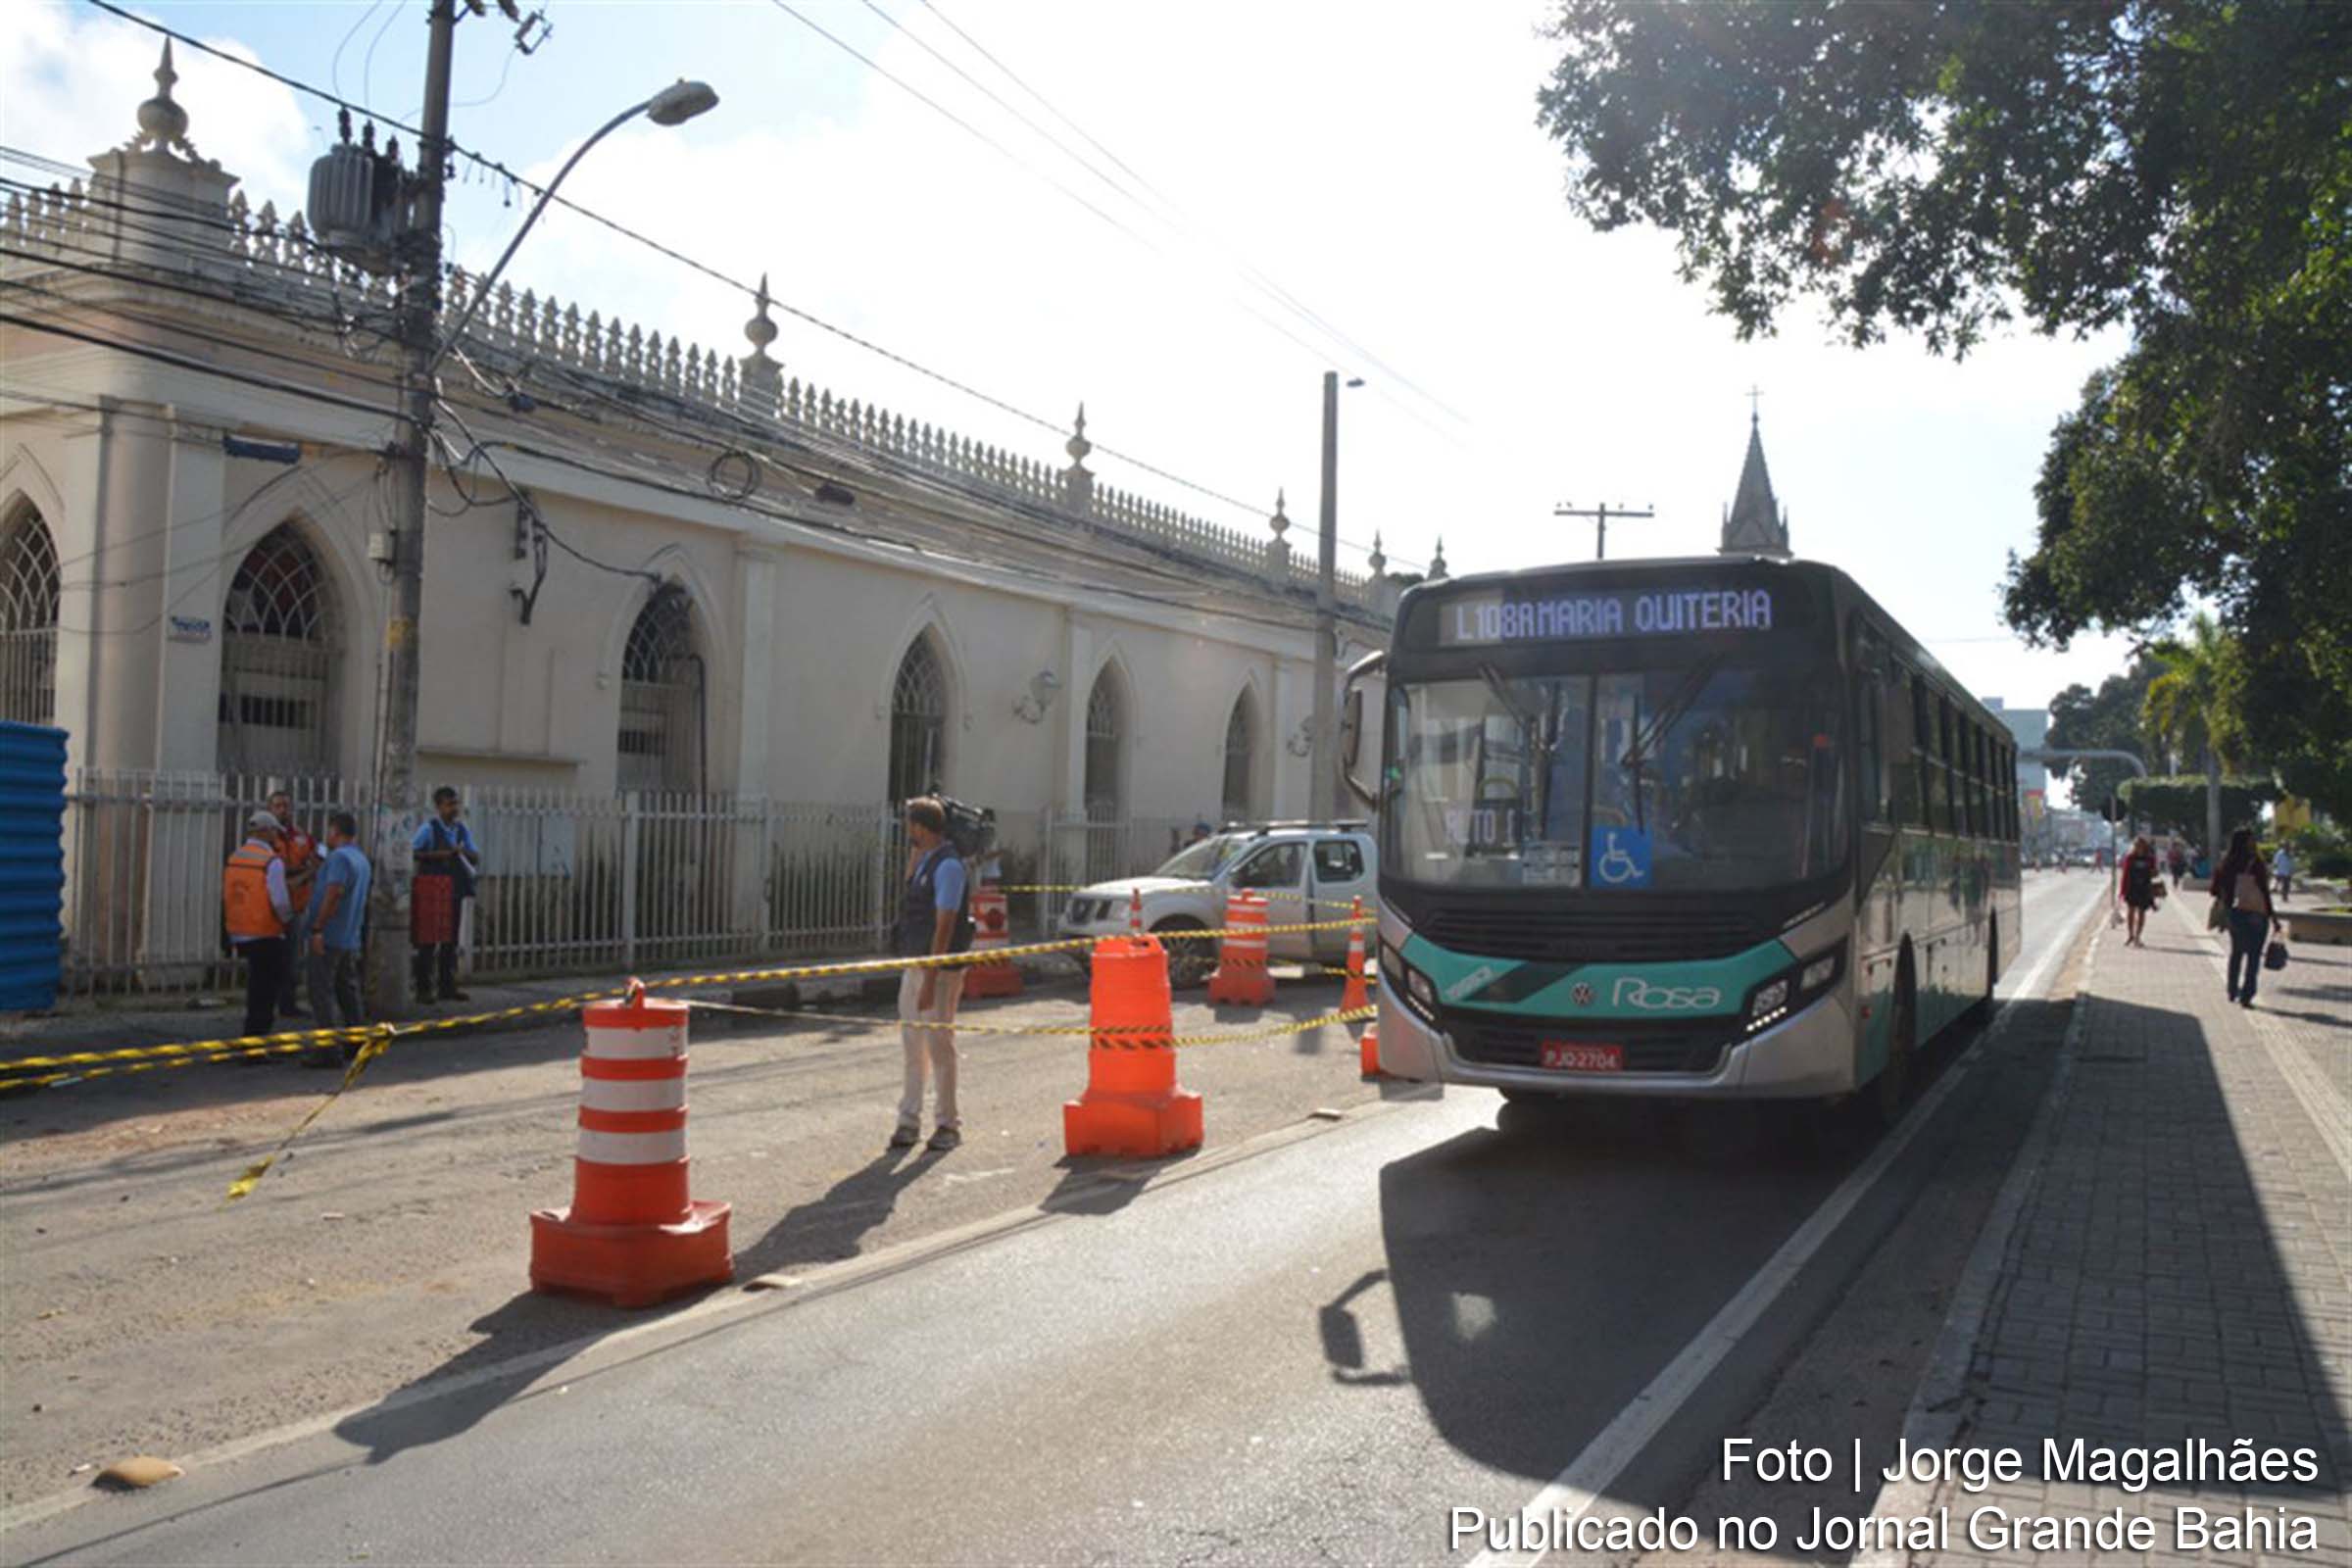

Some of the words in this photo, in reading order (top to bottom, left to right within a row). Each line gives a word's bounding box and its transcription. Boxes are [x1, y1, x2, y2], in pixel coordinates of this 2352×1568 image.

[1537, 598, 1624, 637] MARIA
[1634, 590, 1772, 632] QUITERIA
[1612, 977, 1723, 1009] Rosa
